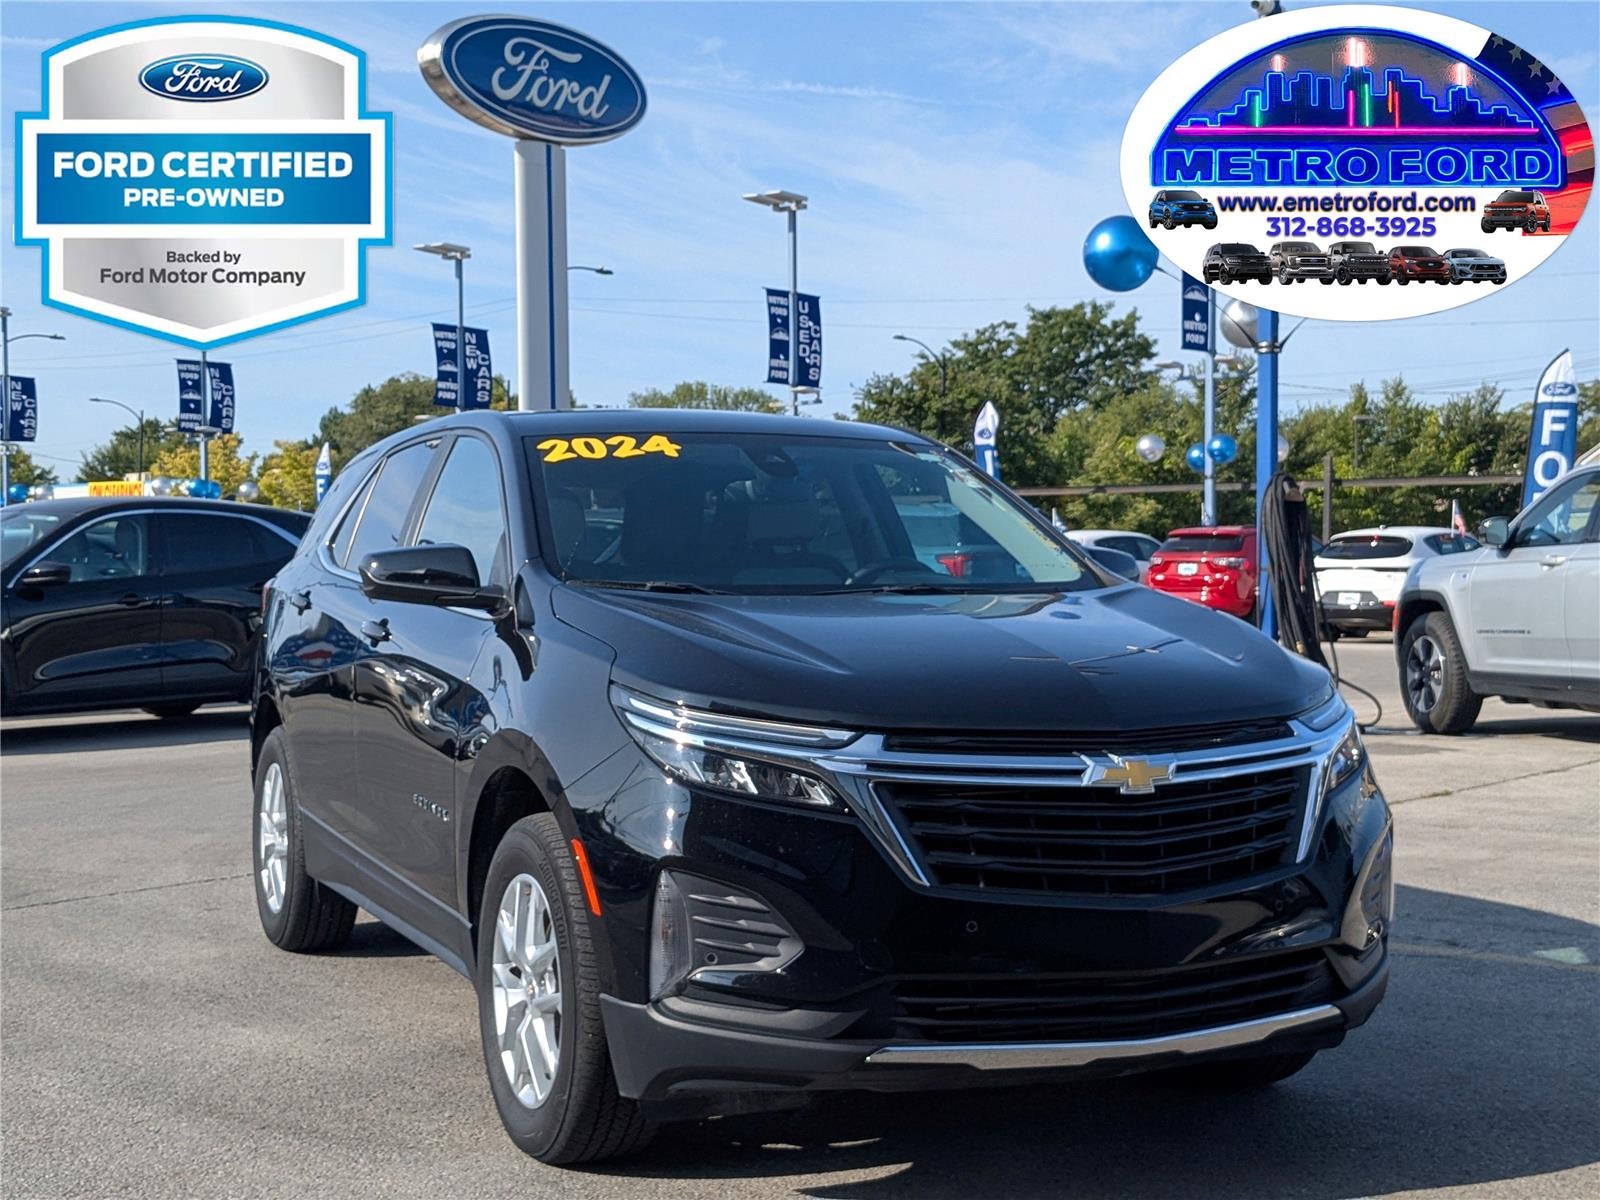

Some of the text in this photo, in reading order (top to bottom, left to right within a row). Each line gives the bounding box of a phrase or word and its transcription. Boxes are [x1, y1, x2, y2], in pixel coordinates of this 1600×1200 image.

[491, 37, 612, 120] Ford
[464, 332, 490, 402] NEW CARS
[798, 301, 821, 380] USED CARS
[11, 381, 36, 438] NEW CARS
[210, 367, 233, 429] NEW CARS
[536, 434, 683, 464] 2024
[1533, 408, 1570, 500] FO
